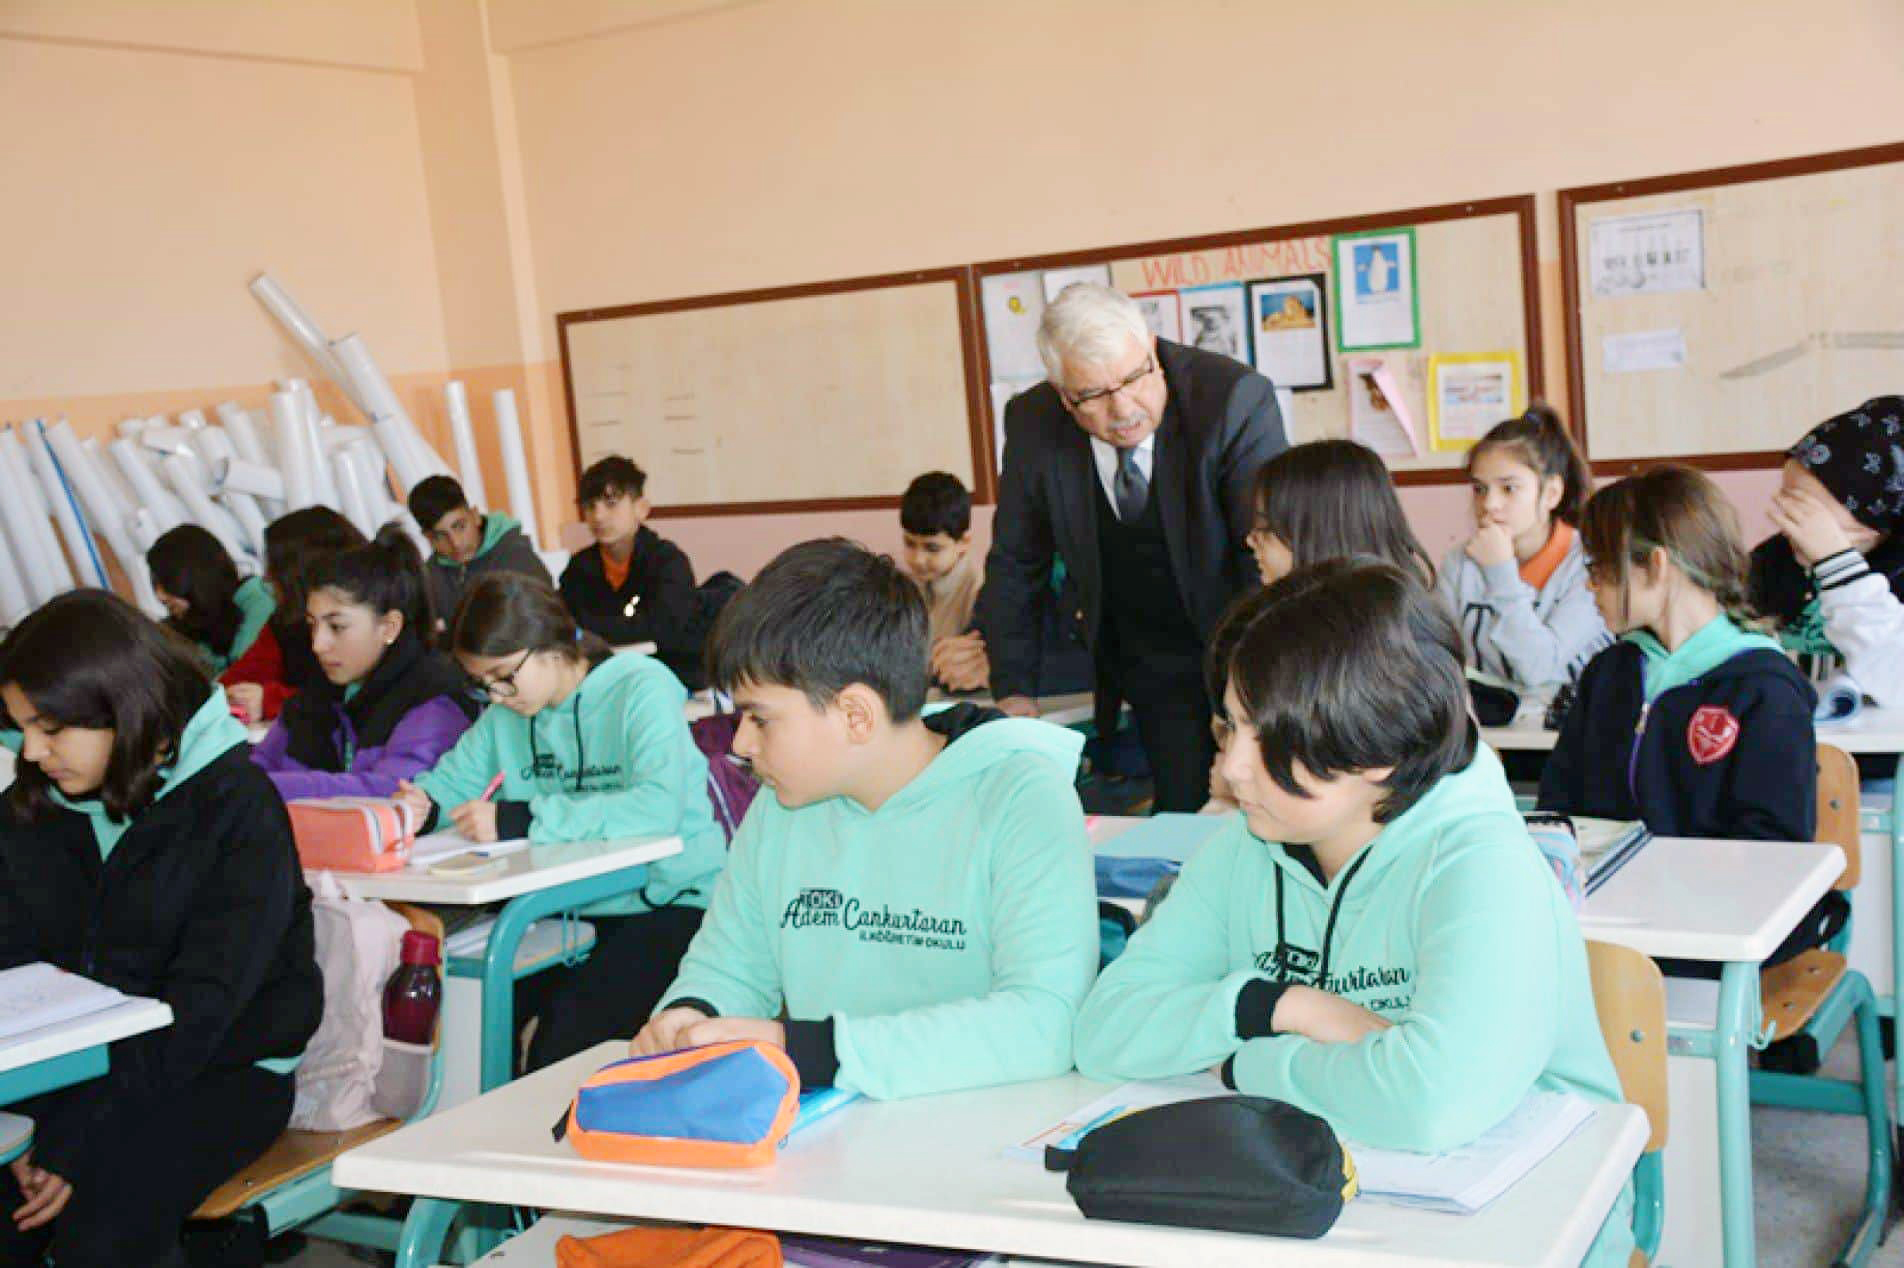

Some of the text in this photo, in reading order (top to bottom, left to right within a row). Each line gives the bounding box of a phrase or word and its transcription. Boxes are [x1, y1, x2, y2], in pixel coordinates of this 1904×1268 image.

[1141, 235, 1332, 288] WILD ANIMALS
[779, 896, 967, 936] Adem Cankurtaran
